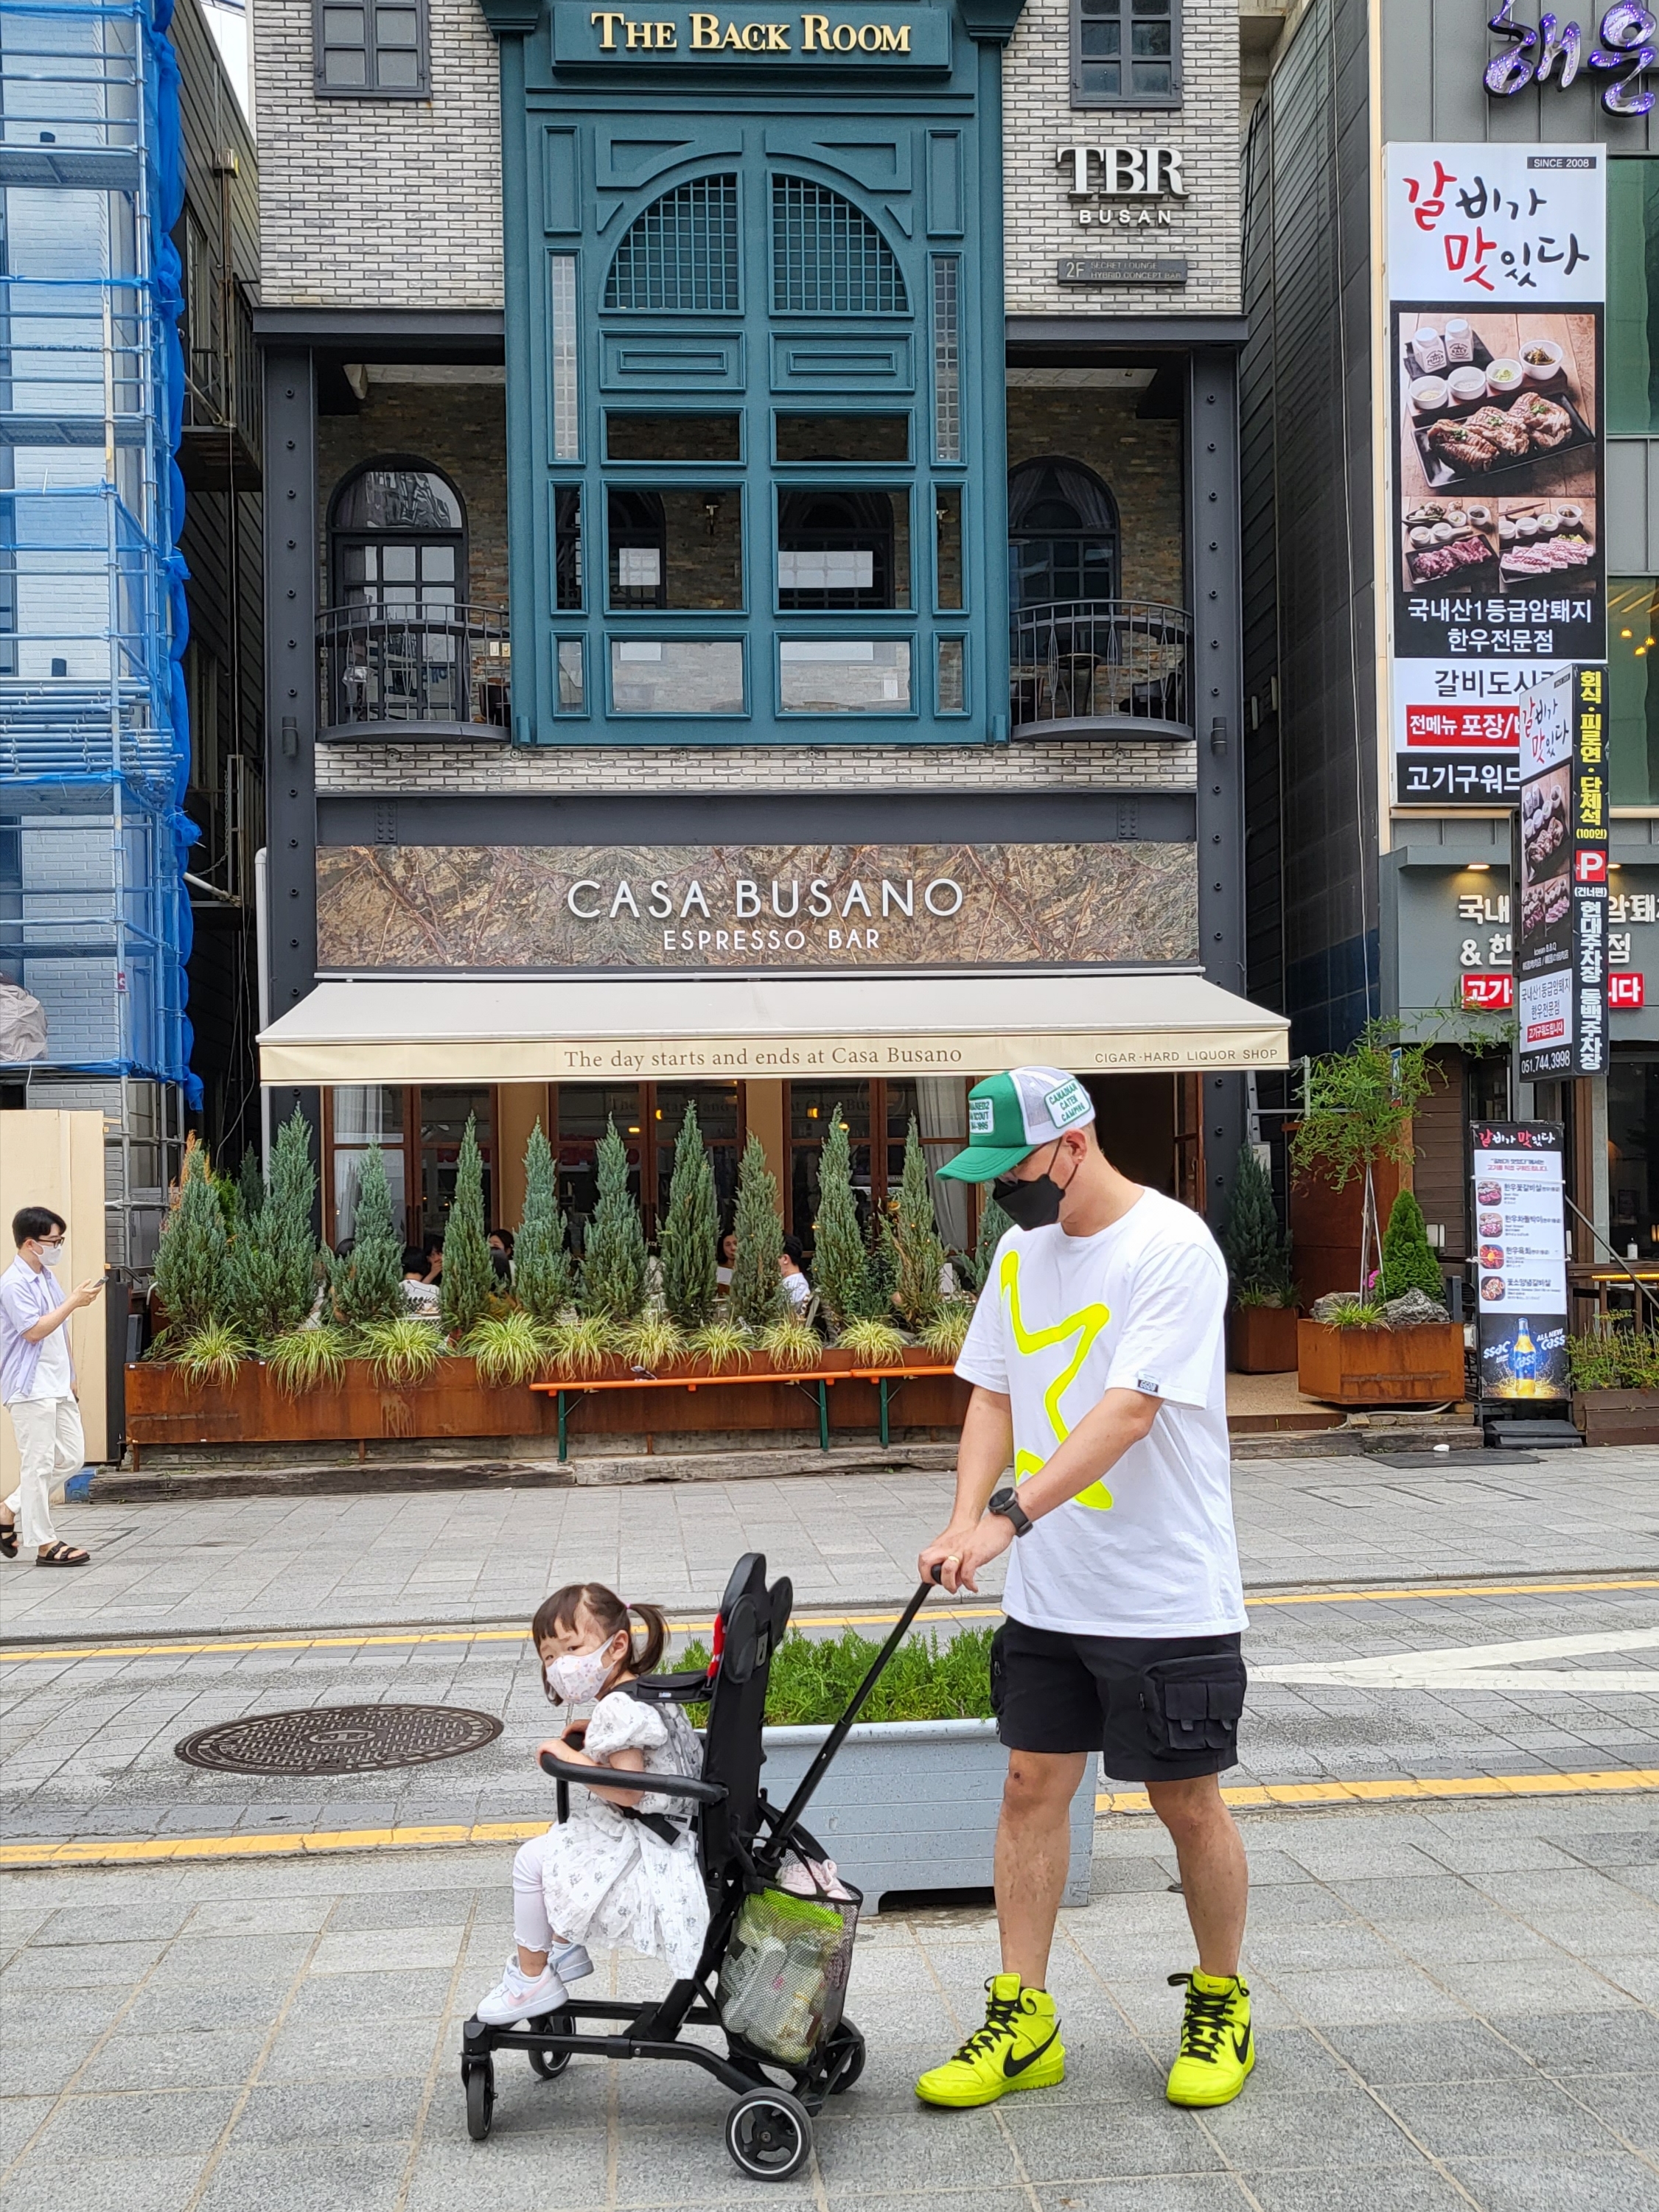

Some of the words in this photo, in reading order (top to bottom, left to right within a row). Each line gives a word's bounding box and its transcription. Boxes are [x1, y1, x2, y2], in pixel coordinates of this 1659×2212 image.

[1057, 146, 1190, 197] TBR
[1534, 158, 1562, 168] SINCE
[1566, 158, 1590, 168] 2008
[1403, 161, 1547, 231] 갈비가
[1079, 209, 1172, 225] BUSAN
[1066, 262, 1086, 278] 2F
[1444, 226, 1590, 292] 맛있다
[1447, 628, 1554, 654] 한우전문점
[1410, 716, 1458, 736] 전메뉴
[1522, 696, 1558, 738] 갈비가
[1532, 718, 1569, 764] 맛있다
[1576, 828, 1607, 839] (100인)
[1581, 853, 1603, 880] P
[567, 880, 712, 919] CASA
[736, 878, 964, 918] BUSANO
[1574, 887, 1607, 897] (건너편)
[664, 929, 806, 951] ESPRESSO
[828, 928, 880, 949] BAR
[1579, 900, 1602, 984] 현대주차장
[1460, 939, 1484, 966] &
[1531, 999, 1560, 1020] 한우전문점
[1579, 988, 1602, 1071] 동백주차장
[564, 1051, 603, 1068] The
[611, 1049, 645, 1071] day
[651, 1050, 705, 1066] starts
[712, 1048, 748, 1065] and
[755, 1048, 800, 1065] ends
[808, 1049, 825, 1063] at
[831, 1048, 879, 1064] Casa
[887, 1046, 963, 1063] Busano
[1187, 1050, 1236, 1061] LIQUOR
[1243, 1049, 1278, 1060] SHOP
[1521, 1050, 1571, 1074] 051.744.3998
[1049, 1082, 1078, 1105] CANADIAN
[1061, 1102, 1086, 1121] CAMPING
[1478, 1128, 1516, 1148] 갈비가
[1517, 1130, 1555, 1148] 맛있다
[1537, 1334, 1548, 1342] ALL
[1548, 1328, 1563, 1337] NEW
